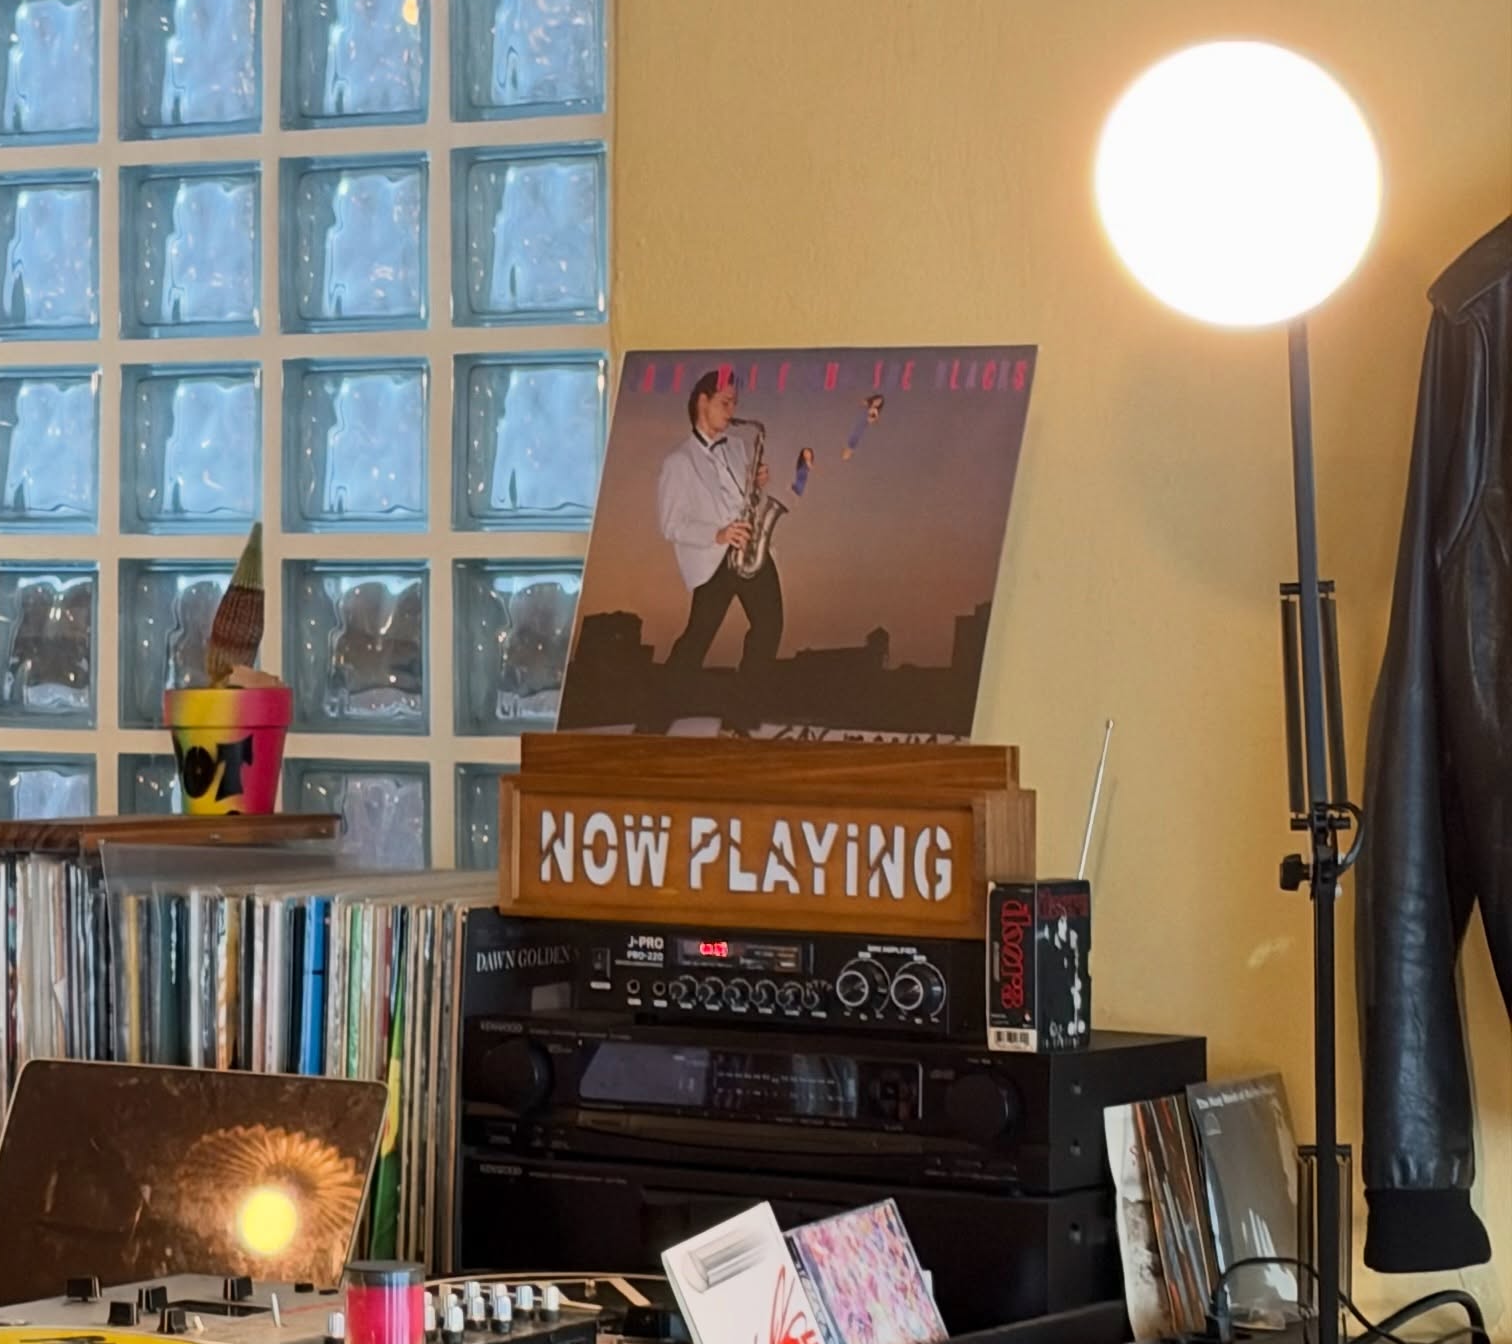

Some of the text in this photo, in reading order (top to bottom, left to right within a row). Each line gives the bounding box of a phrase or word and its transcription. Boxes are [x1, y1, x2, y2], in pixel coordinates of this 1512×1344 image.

[172, 729, 253, 802] OT
[539, 810, 953, 902] NOW PLAYING
[476, 946, 570, 972] DAWN GOLDEN
[628, 936, 664, 950] J-PRO
